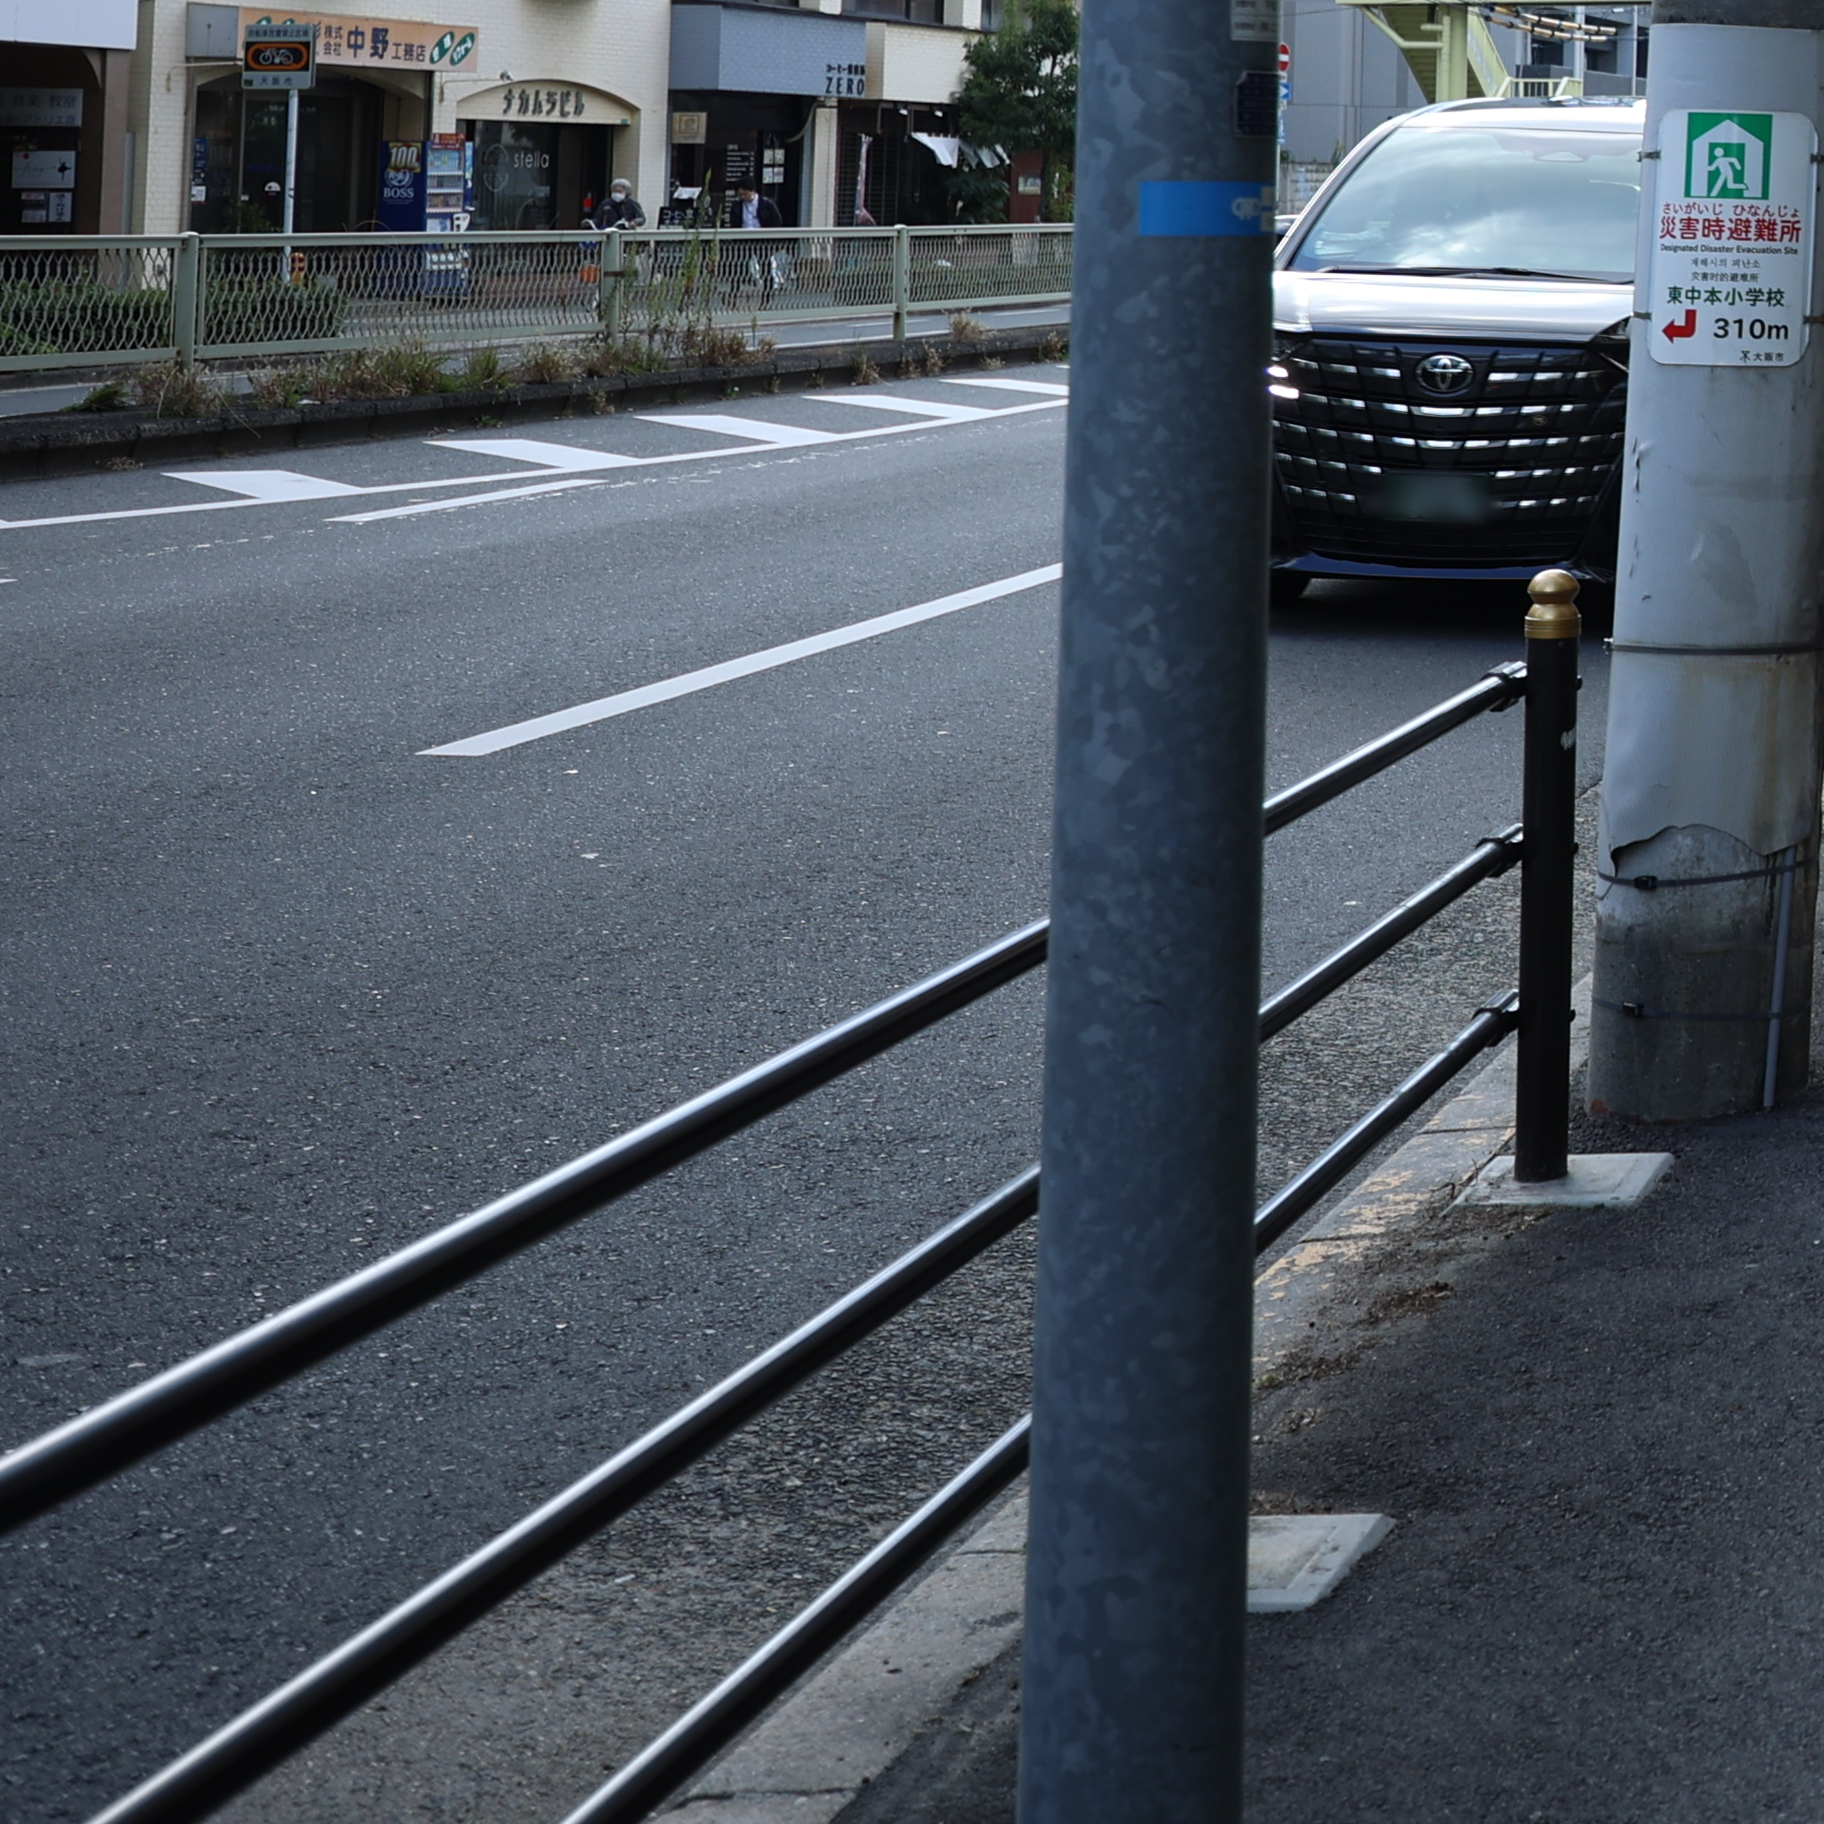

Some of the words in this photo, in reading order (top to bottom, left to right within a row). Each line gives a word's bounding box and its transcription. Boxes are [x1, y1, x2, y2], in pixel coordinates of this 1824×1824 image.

[825, 77, 865, 96] ZERO
[503, 88, 585, 117] ナカムラビル
[514, 150, 550, 168] stella
[383, 187, 415, 198] BOSS
[1663, 202, 1723, 215] さいがいじ
[1732, 204, 1800, 218] ひなんじょ
[1659, 216, 1802, 243] 災害時避難所
[1660, 243, 1698, 254] Designated
[1700, 244, 1734, 253] Disaster
[1736, 245, 1782, 255] Evacuation
[1784, 246, 1798, 255] Site
[1667, 286, 1785, 307] 東中本小学校
[1713, 317, 1789, 340] 310m
[1752, 351, 1785, 362] 大阪市
